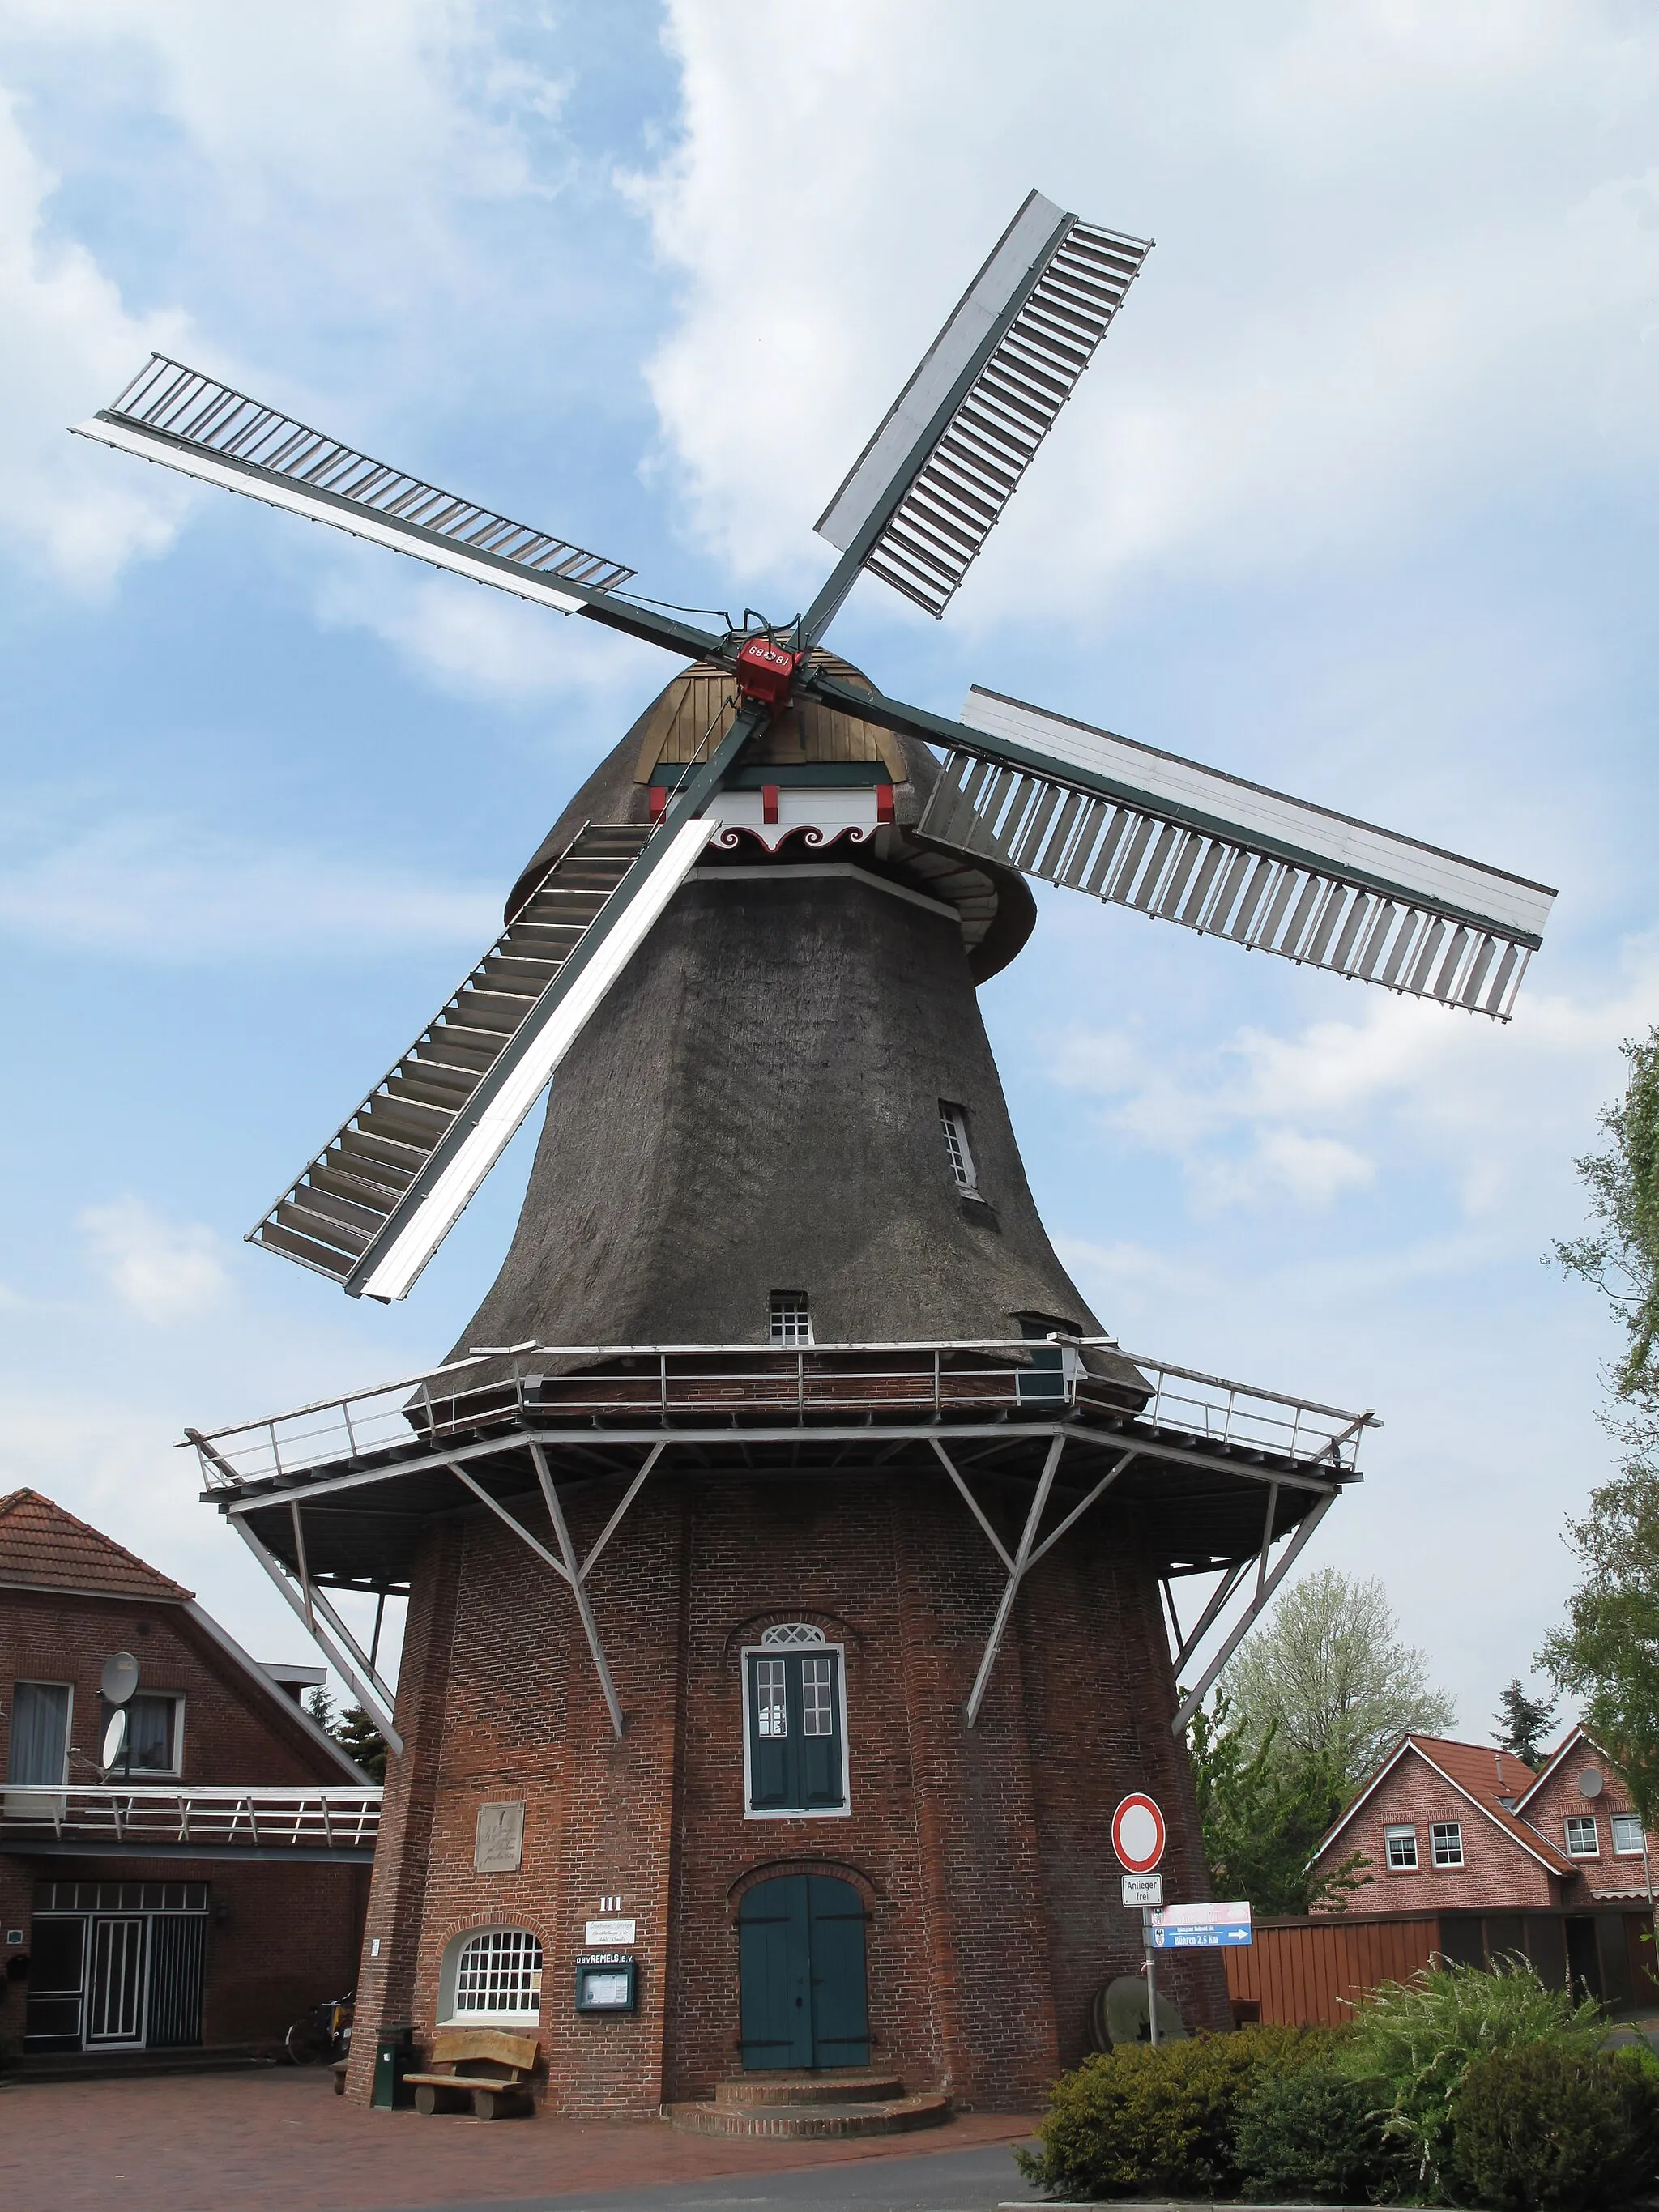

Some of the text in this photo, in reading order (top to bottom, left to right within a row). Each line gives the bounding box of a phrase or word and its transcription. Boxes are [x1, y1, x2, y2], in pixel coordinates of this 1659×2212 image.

[749, 646, 789, 666] 68 81
[1127, 1881, 1157, 1891] Anlieger
[1137, 1892, 1149, 1901] frei
[599, 1896, 621, 1912] 111
[1175, 1935, 1196, 1946] Bühren
[1209, 1934, 1218, 1944] km
